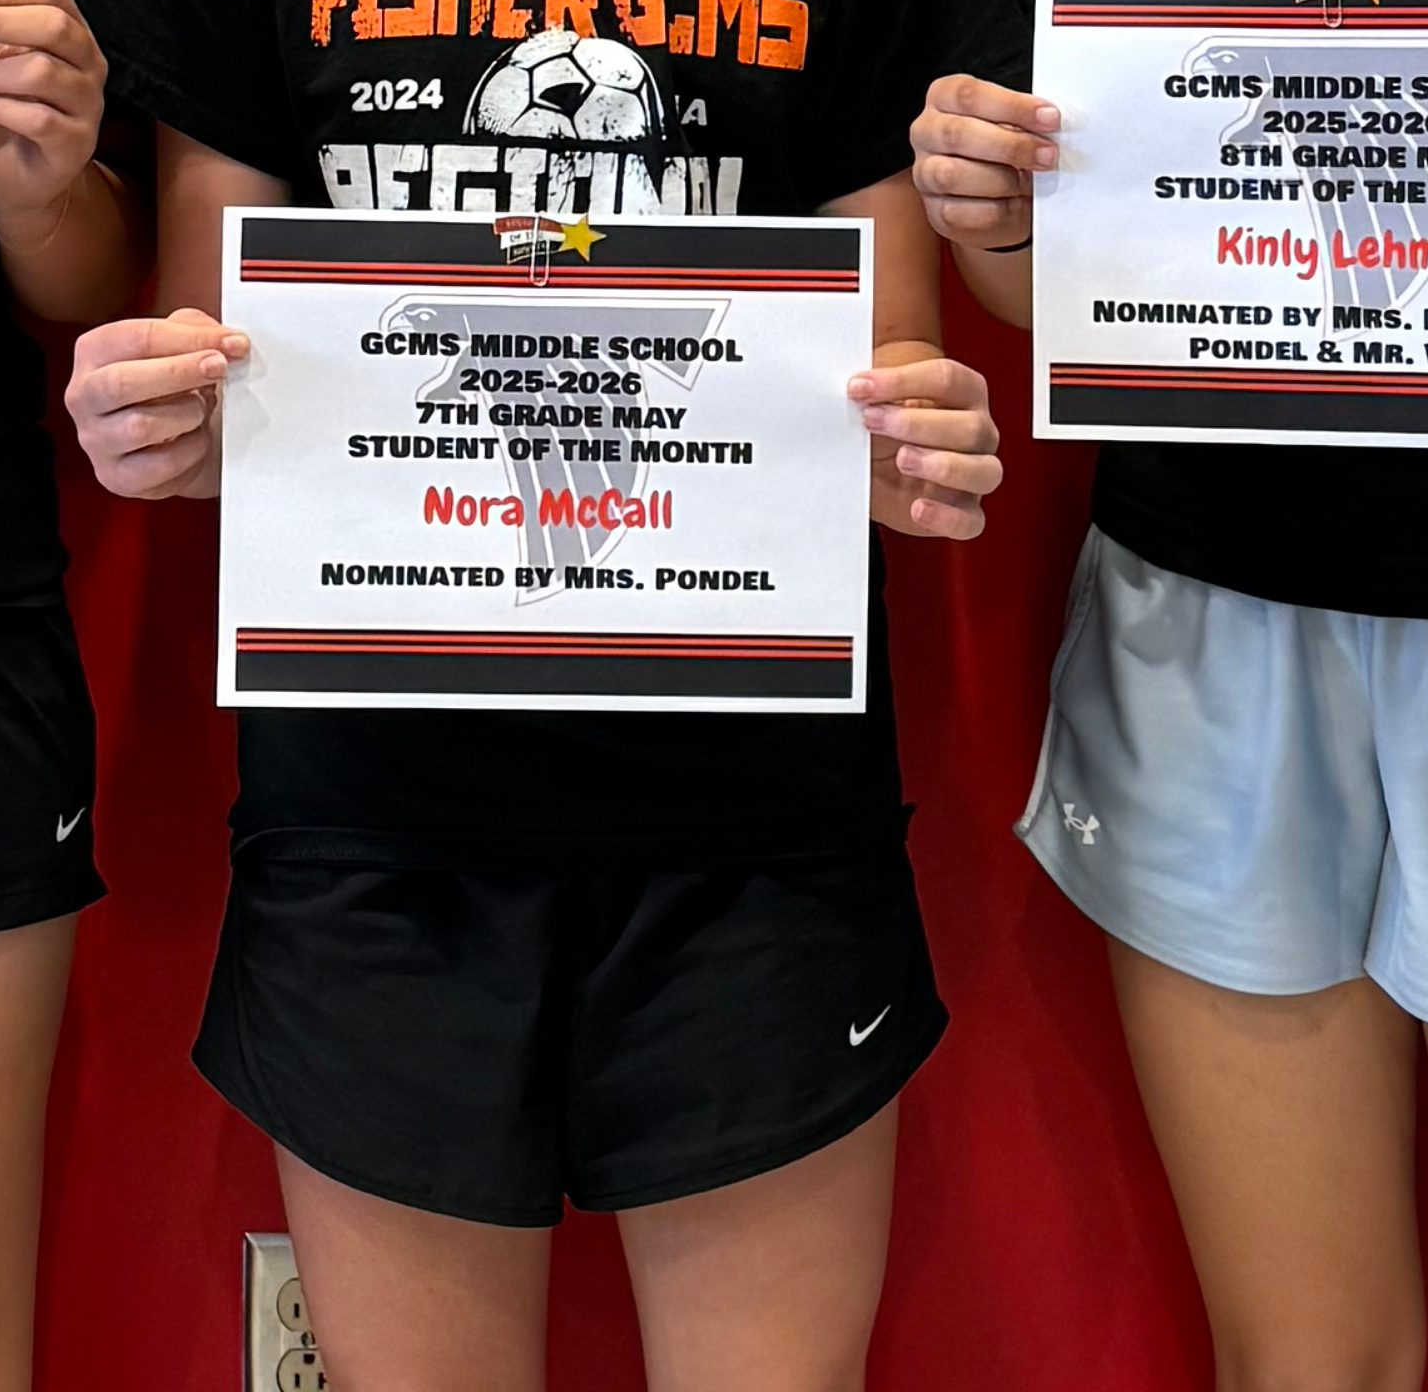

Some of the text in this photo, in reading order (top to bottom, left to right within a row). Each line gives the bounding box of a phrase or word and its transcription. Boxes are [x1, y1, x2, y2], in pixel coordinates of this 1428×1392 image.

[350, 78, 444, 112] 2024
[1164, 75, 1263, 99] GCMS
[1273, 76, 1402, 100] MIDDLE
[1220, 143, 1282, 167] 8TH
[1292, 145, 1407, 169] GRADE
[1155, 176, 1304, 201] STUDENT
[1312, 179, 1355, 203] OF
[1363, 180, 1426, 204] THE
[1217, 226, 1319, 279] Kinly
[360, 332, 743, 362] GCMS MIDDLE SCHOOL
[1317, 340, 1343, 363] &
[459, 368, 642, 396] 2025-2026
[415, 401, 687, 430] 7TH GRADE MAY
[348, 434, 753, 464] STUDENT OF THE MONTH
[423, 485, 672, 530] Nora McCall
